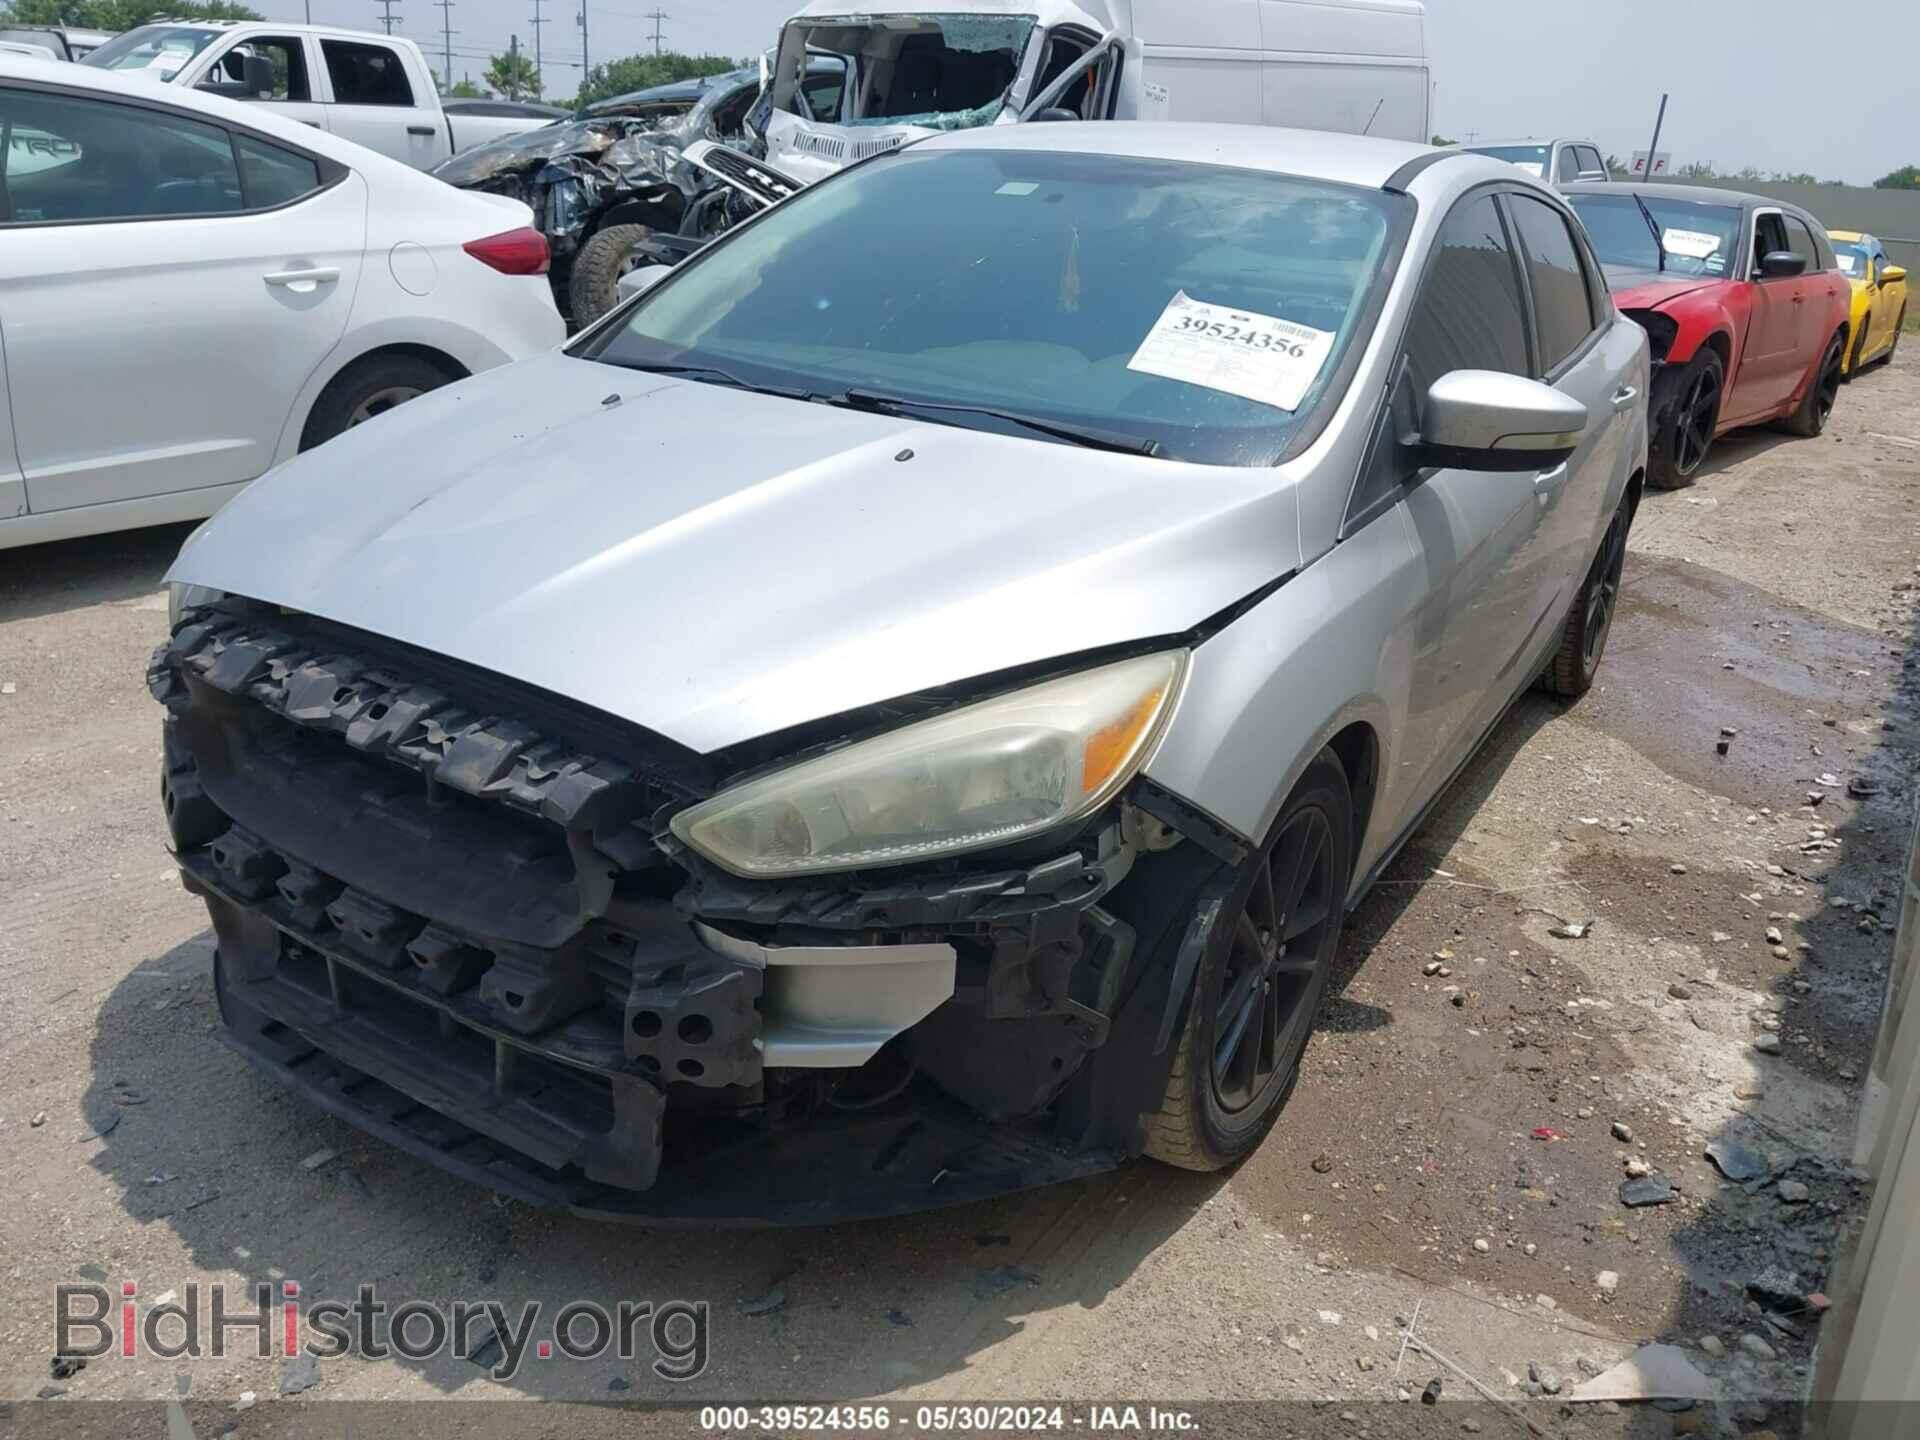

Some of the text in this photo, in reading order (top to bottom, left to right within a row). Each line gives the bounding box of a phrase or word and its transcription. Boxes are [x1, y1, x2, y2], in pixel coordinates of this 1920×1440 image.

[1634, 159, 1664, 171] E F
[746, 167, 793, 197] RA
[1173, 315, 1305, 358] 39524356
